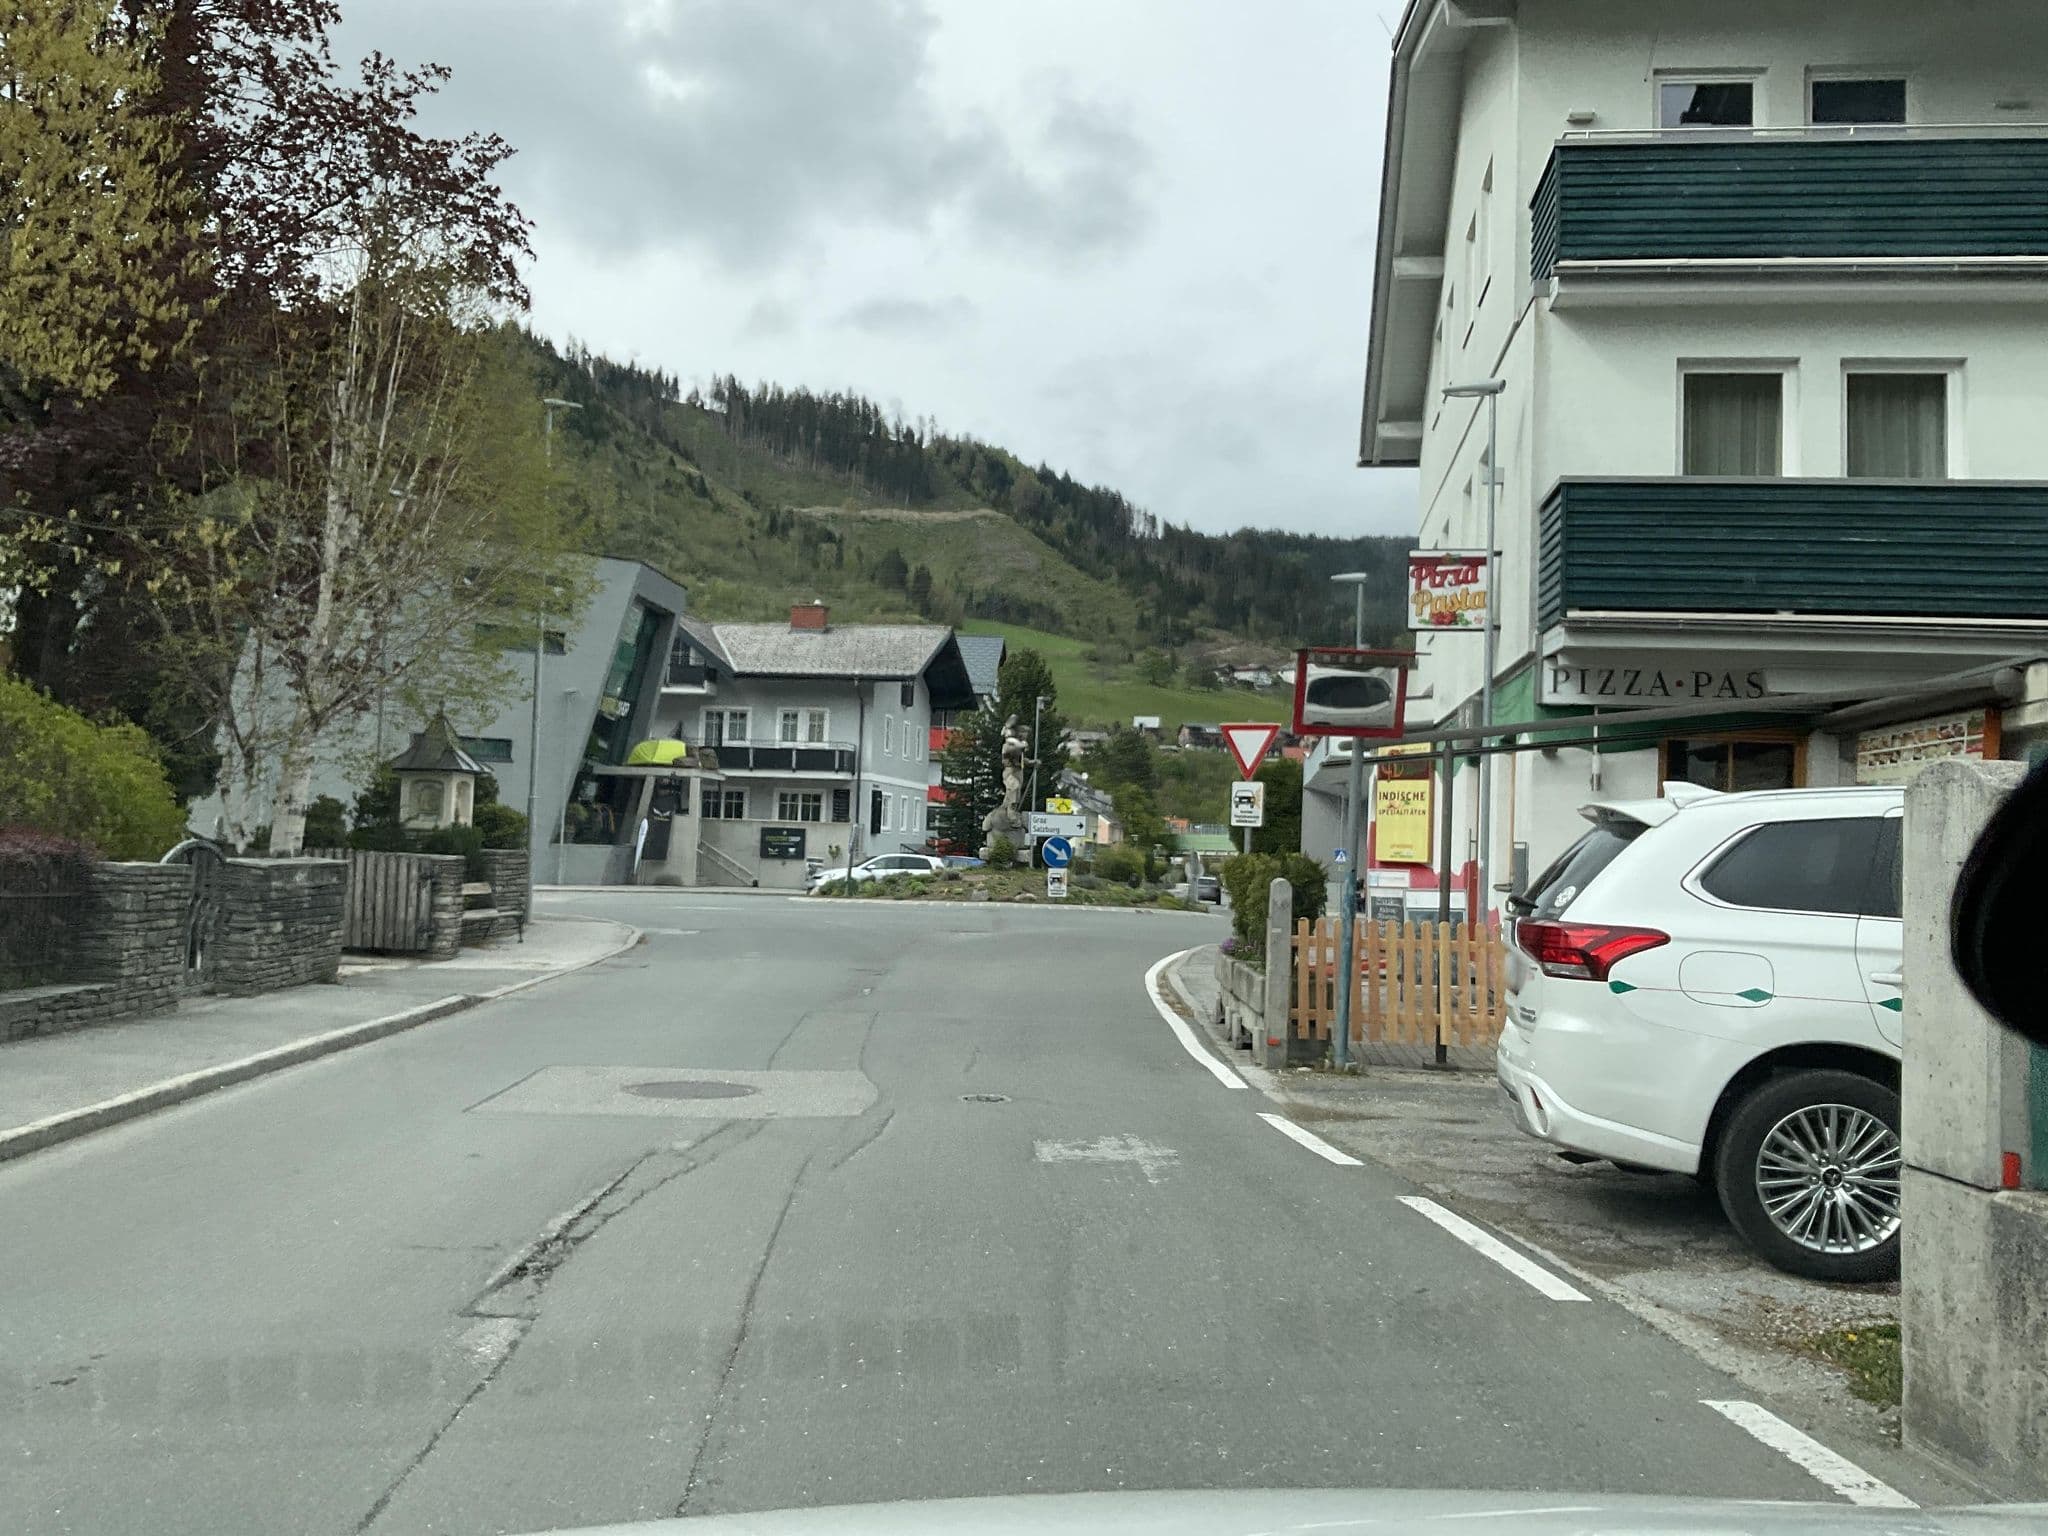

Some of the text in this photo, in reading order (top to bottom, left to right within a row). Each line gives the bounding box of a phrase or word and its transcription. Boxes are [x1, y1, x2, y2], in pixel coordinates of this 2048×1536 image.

[1410, 564, 1479, 592] Pizza
[1411, 587, 1486, 617] Pasta
[1549, 668, 1672, 697] PIZZA
[1379, 791, 1425, 801] INDISCHE
[1033, 825, 1059, 834] Salzburg
